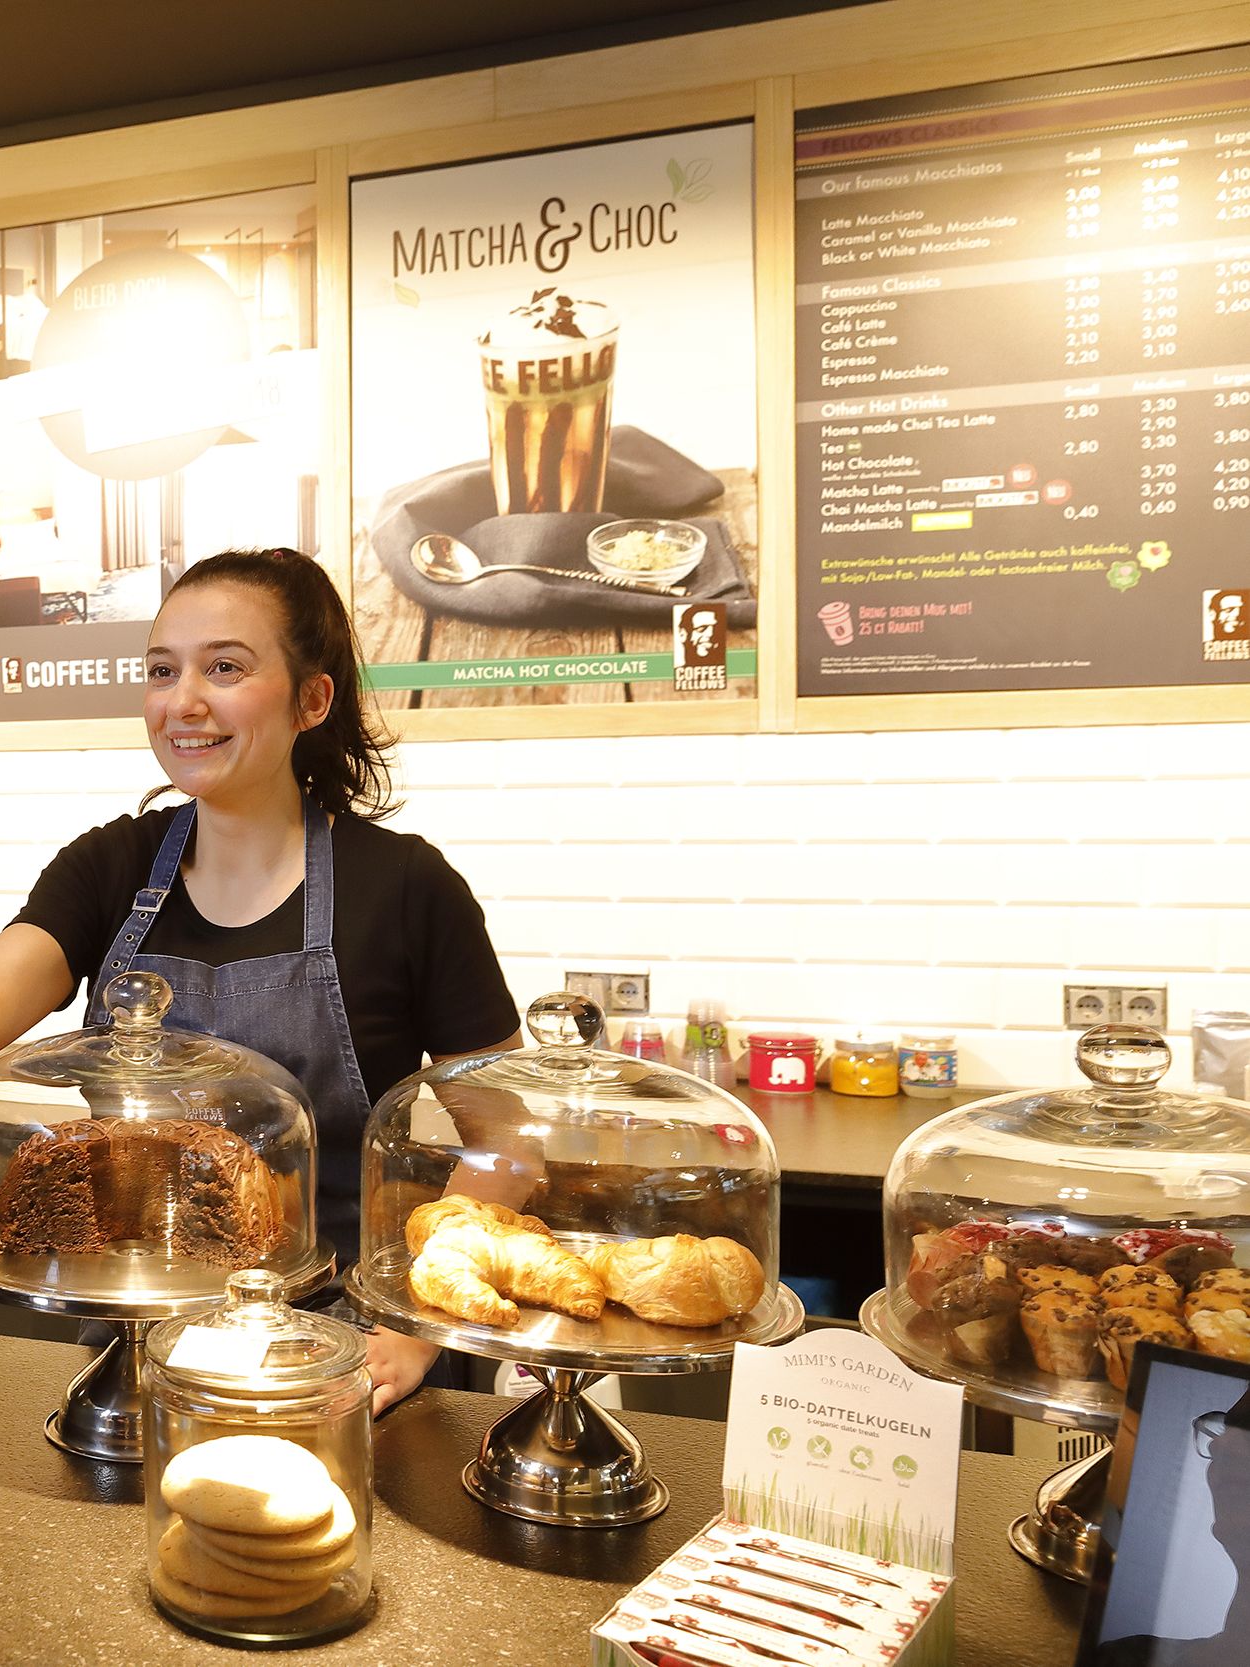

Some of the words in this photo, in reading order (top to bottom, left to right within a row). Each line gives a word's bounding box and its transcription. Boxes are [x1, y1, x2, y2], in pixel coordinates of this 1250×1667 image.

[1065, 147, 1101, 163] Small
[822, 179, 851, 194] Our
[856, 174, 909, 190] famous
[914, 161, 1003, 182] Macchiatos
[821, 231, 876, 249] Caramel
[879, 230, 893, 241] or
[897, 223, 942, 239] Vanilla
[946, 214, 1017, 234] Macchiato
[822, 217, 852, 231] Latte
[856, 208, 924, 227] Macchiato
[392, 222, 527, 278] MATCHA
[534, 197, 582, 274] &
[589, 202, 678, 253] CHOC
[822, 251, 856, 266] Black
[859, 251, 874, 262] or
[877, 244, 916, 259] White
[920, 236, 991, 255] Macchiato
[822, 281, 878, 300] Famous
[882, 274, 941, 294] Classics
[821, 318, 852, 336] Café
[855, 317, 886, 332] Latte
[1142, 286, 1178, 304] 3,70
[1216, 279, 1250, 296] 4,10
[821, 300, 897, 319] Cappuccino
[821, 335, 852, 352] Café
[855, 332, 897, 349] Crème
[1142, 304, 1178, 322] 2,90
[822, 353, 877, 370] Espresso
[1065, 331, 1099, 348] 2,10
[1142, 323, 1177, 340] 3,00
[822, 371, 876, 388] Espresso
[880, 364, 949, 382] Macchiato
[1064, 349, 1099, 365] 2,20
[1143, 342, 1176, 359] 3,10
[822, 400, 865, 418] Other
[869, 397, 897, 414] Hot
[901, 395, 948, 413] Drinks
[822, 423, 859, 439] Home
[862, 419, 899, 435] made
[902, 416, 933, 432] Chai
[934, 414, 960, 429] Tea
[963, 412, 996, 428] Latte
[1064, 403, 1099, 420] 2,80
[1142, 397, 1177, 414] 3,30
[1214, 391, 1250, 408] 3,80
[820, 441, 844, 456] Tea
[1141, 416, 1177, 432] 2,90
[822, 458, 846, 473] Hot
[848, 453, 914, 470] Chocolate
[1064, 439, 1099, 456] 2,80
[1142, 434, 1177, 450] 3,30
[1214, 428, 1250, 445] 3,80
[821, 485, 869, 500] Matcha
[872, 483, 904, 497] Latte
[1141, 463, 1177, 480] 3,70
[1214, 458, 1250, 475] 4,20
[821, 501, 851, 517] Chai
[854, 500, 903, 515] Matcha
[906, 498, 937, 512] Latte
[1141, 481, 1177, 497] 3,70
[1214, 477, 1250, 494] 4,20
[821, 517, 903, 534] Mandelmilch
[1064, 504, 1099, 521] 0,40
[1141, 500, 1177, 516] 0,60
[1213, 495, 1250, 512] 0,90
[958, 550, 981, 563] Alle
[1040, 545, 1068, 559] auch
[820, 572, 837, 584] mit
[970, 563, 996, 577] oder
[859, 621, 872, 636] 25
[26, 658, 110, 688] COFFEE
[453, 663, 515, 681] MATCHA
[519, 662, 551, 679] HOT
[554, 660, 648, 678] CHOCOLATE
[675, 666, 726, 682] COFFEE
[675, 680, 726, 691] FELLOWS
[820, 1377, 871, 1394] ORGANIC
[842, 1357, 915, 1393] GARDEN
[760, 1394, 768, 1406] 5
[773, 1394, 932, 1439] BIO-DATTELKUGELN
[812, 1418, 840, 1431] organic
[840, 1423, 857, 1434] date
[858, 1427, 880, 1439] treats
